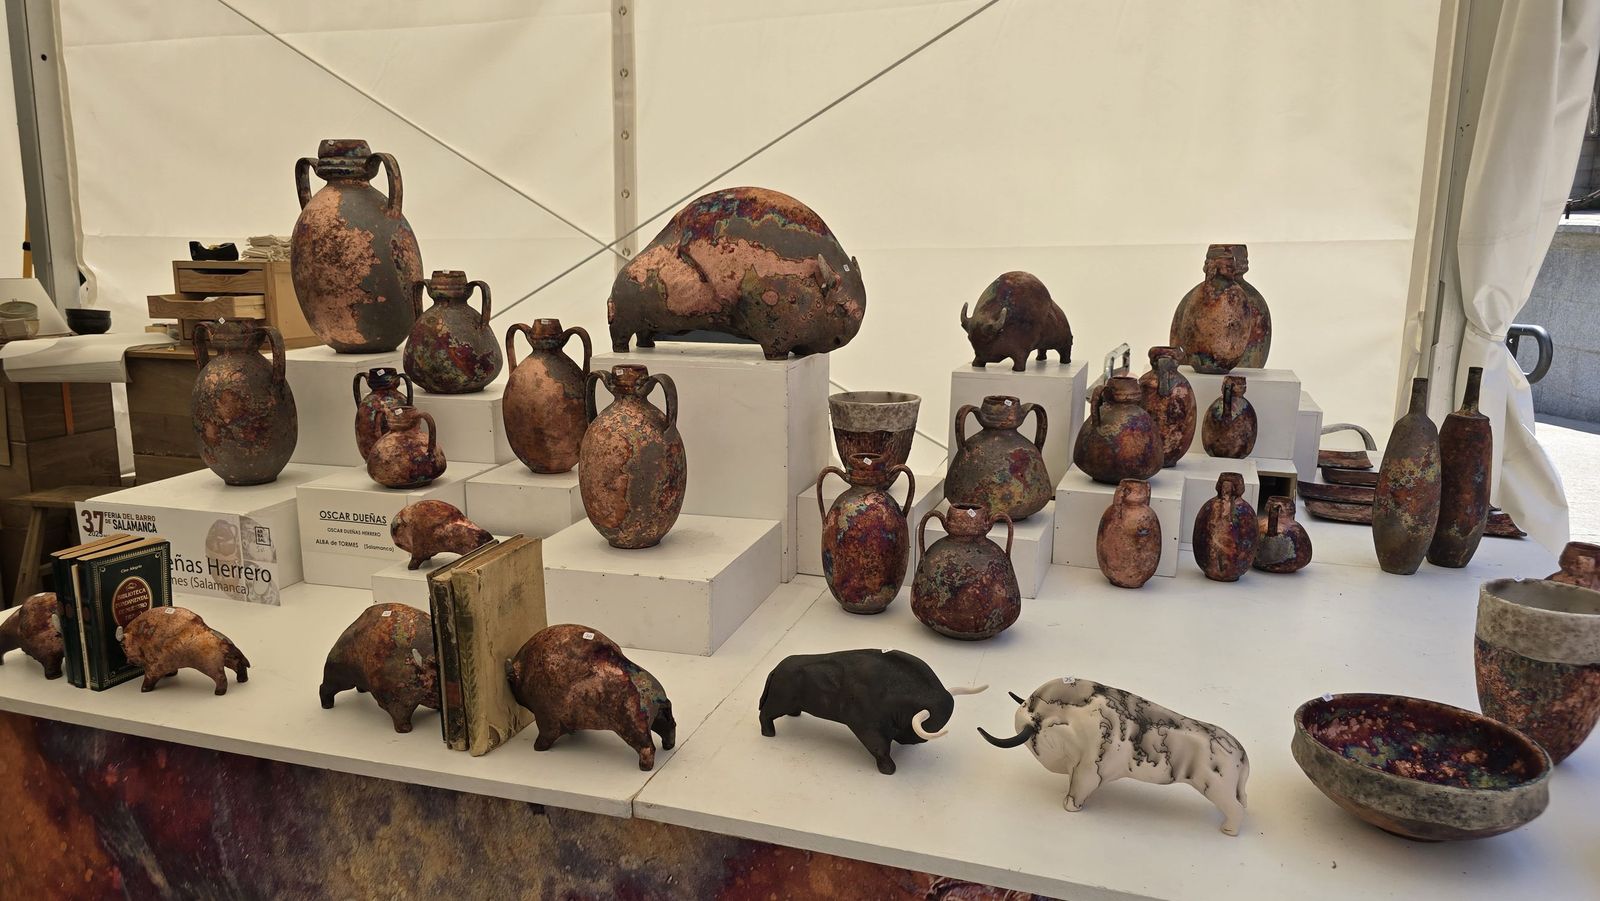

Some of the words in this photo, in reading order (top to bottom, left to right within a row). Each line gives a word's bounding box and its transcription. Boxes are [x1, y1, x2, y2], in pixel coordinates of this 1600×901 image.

[81, 509, 104, 534] 37
[104, 511, 121, 519] FERIA
[122, 513, 134, 521] DEL
[135, 514, 156, 522] BARRO
[320, 510, 350, 521] OSCAR
[352, 512, 387, 525] DUEÑAS
[113, 519, 157, 533] SALAMANCA
[344, 528, 361, 536] DUEÑAS
[339, 540, 359, 548] TORMES
[207, 557, 272, 583] Herrero
[190, 575, 250, 597] (Salamanca)
[117, 588, 147, 601] BIBLIOTECA
